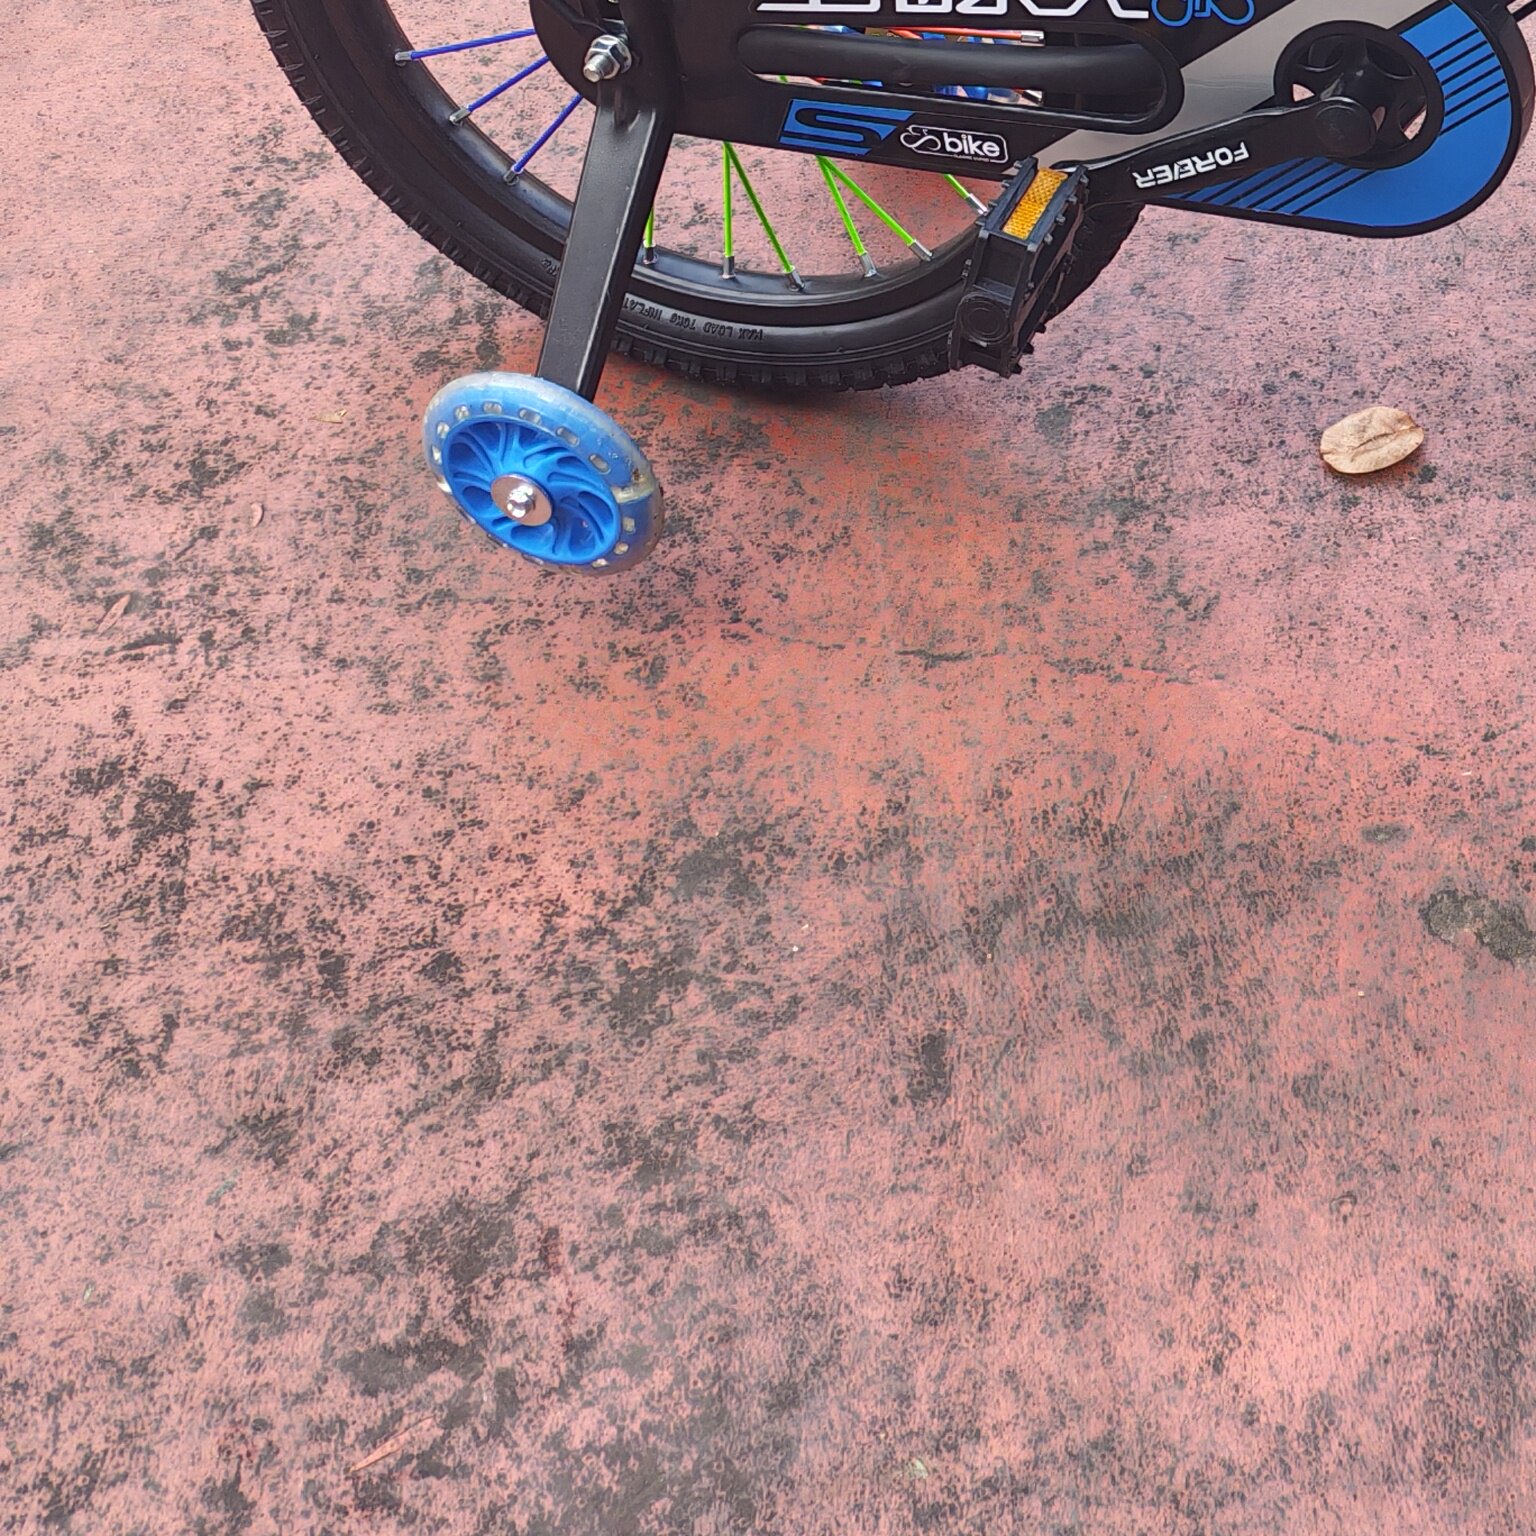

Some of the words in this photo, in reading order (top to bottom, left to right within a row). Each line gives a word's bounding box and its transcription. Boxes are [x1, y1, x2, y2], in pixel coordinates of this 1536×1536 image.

[943, 132, 1000, 158] bike
[1132, 142, 1250, 189] FOREVER
[703, 321, 734, 338] LOAD
